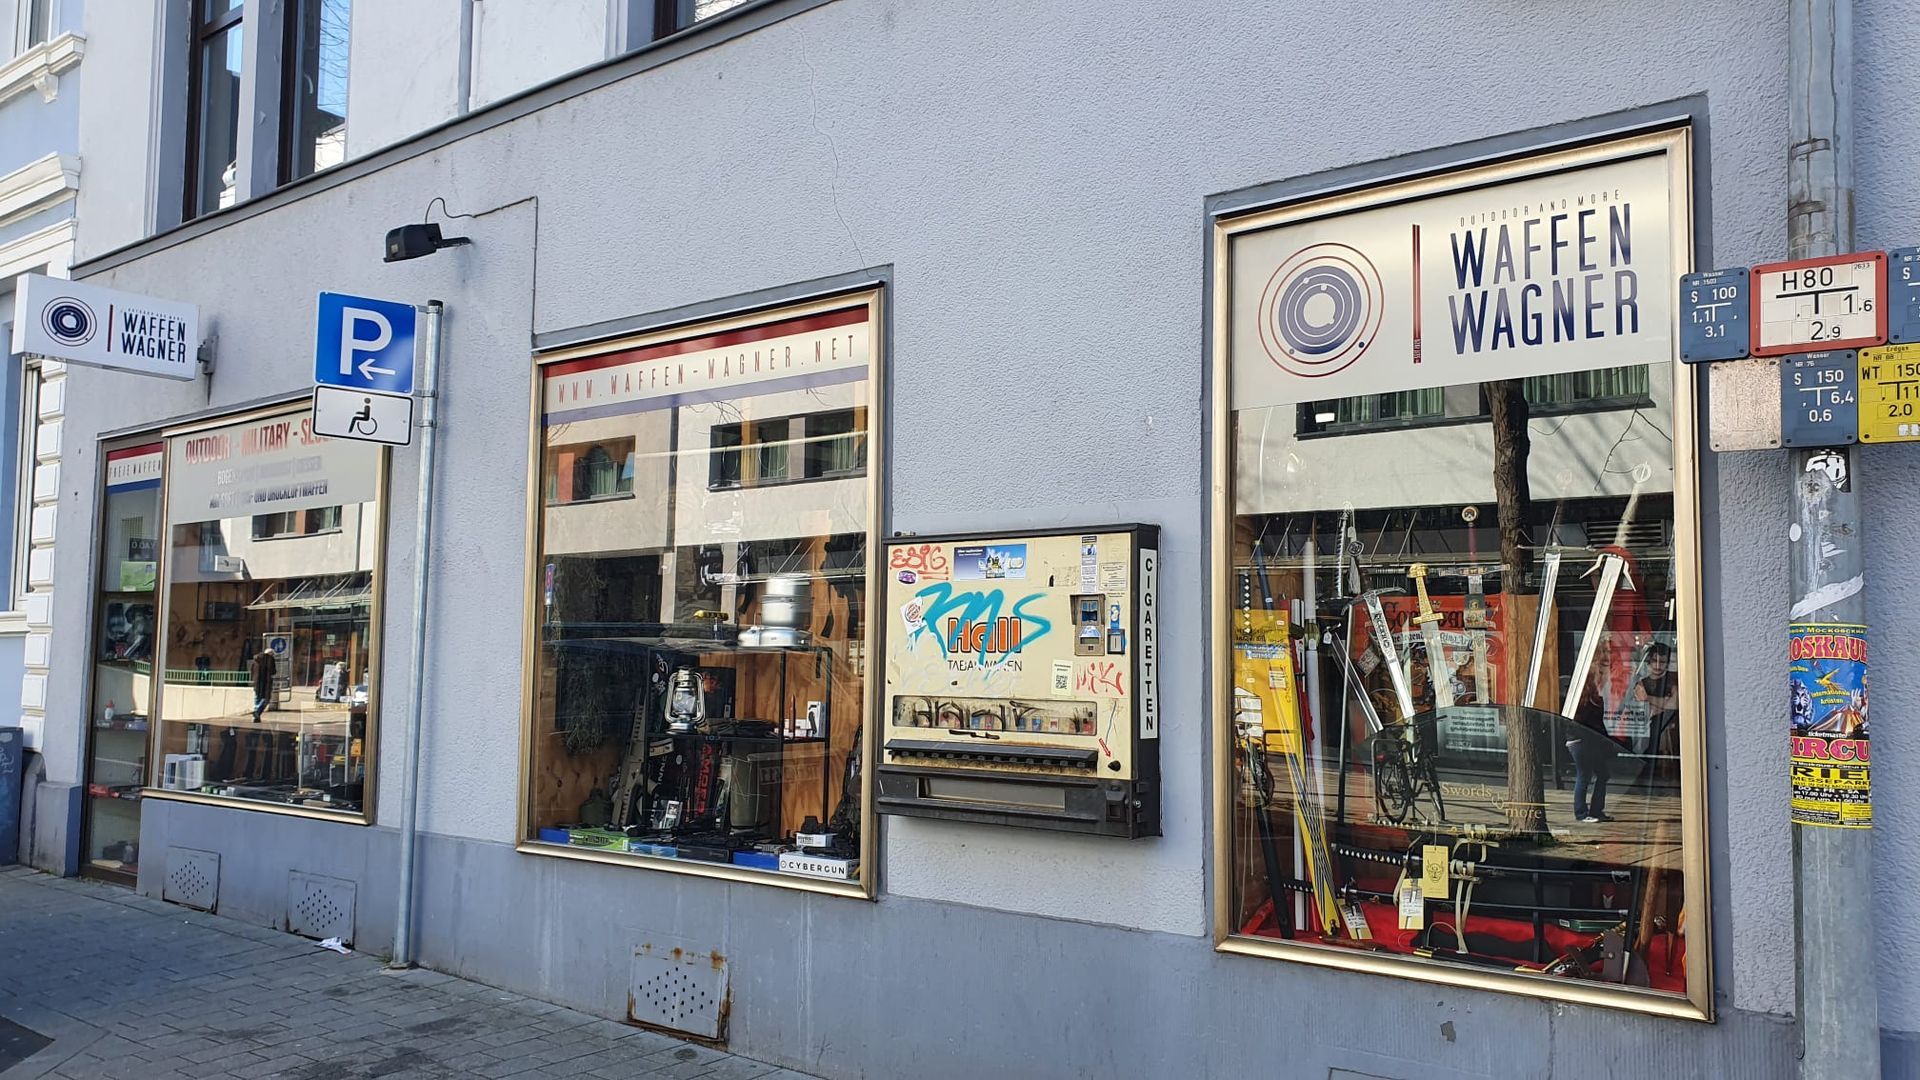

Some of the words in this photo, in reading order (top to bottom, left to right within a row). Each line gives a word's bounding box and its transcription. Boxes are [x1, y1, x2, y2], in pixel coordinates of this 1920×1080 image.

[1460, 204, 1529, 228] OUTDOOR
[1539, 198, 1567, 214] AND
[1577, 189, 1620, 206] MORE
[1450, 203, 1632, 290] WAFFEN
[1691, 290, 1698, 303] S
[1712, 286, 1737, 301] 100
[124, 311, 186, 342] WAFFEN
[1448, 269, 1639, 355] WAGNER
[122, 332, 186, 363] WAGNER
[340, 306, 392, 375] P
[558, 334, 854, 405] WWW.WAFFEN-WAGNER.NET
[1794, 372, 1802, 386] S
[1816, 369, 1844, 384] 150
[1862, 366, 1880, 380] WT
[240, 422, 291, 456] MILITARY
[1143, 557, 1154, 731] CIGARETTEN
[1441, 782, 1492, 798] Swords
[1504, 808, 1542, 820] more
[788, 861, 845, 875] CYBERGUN
